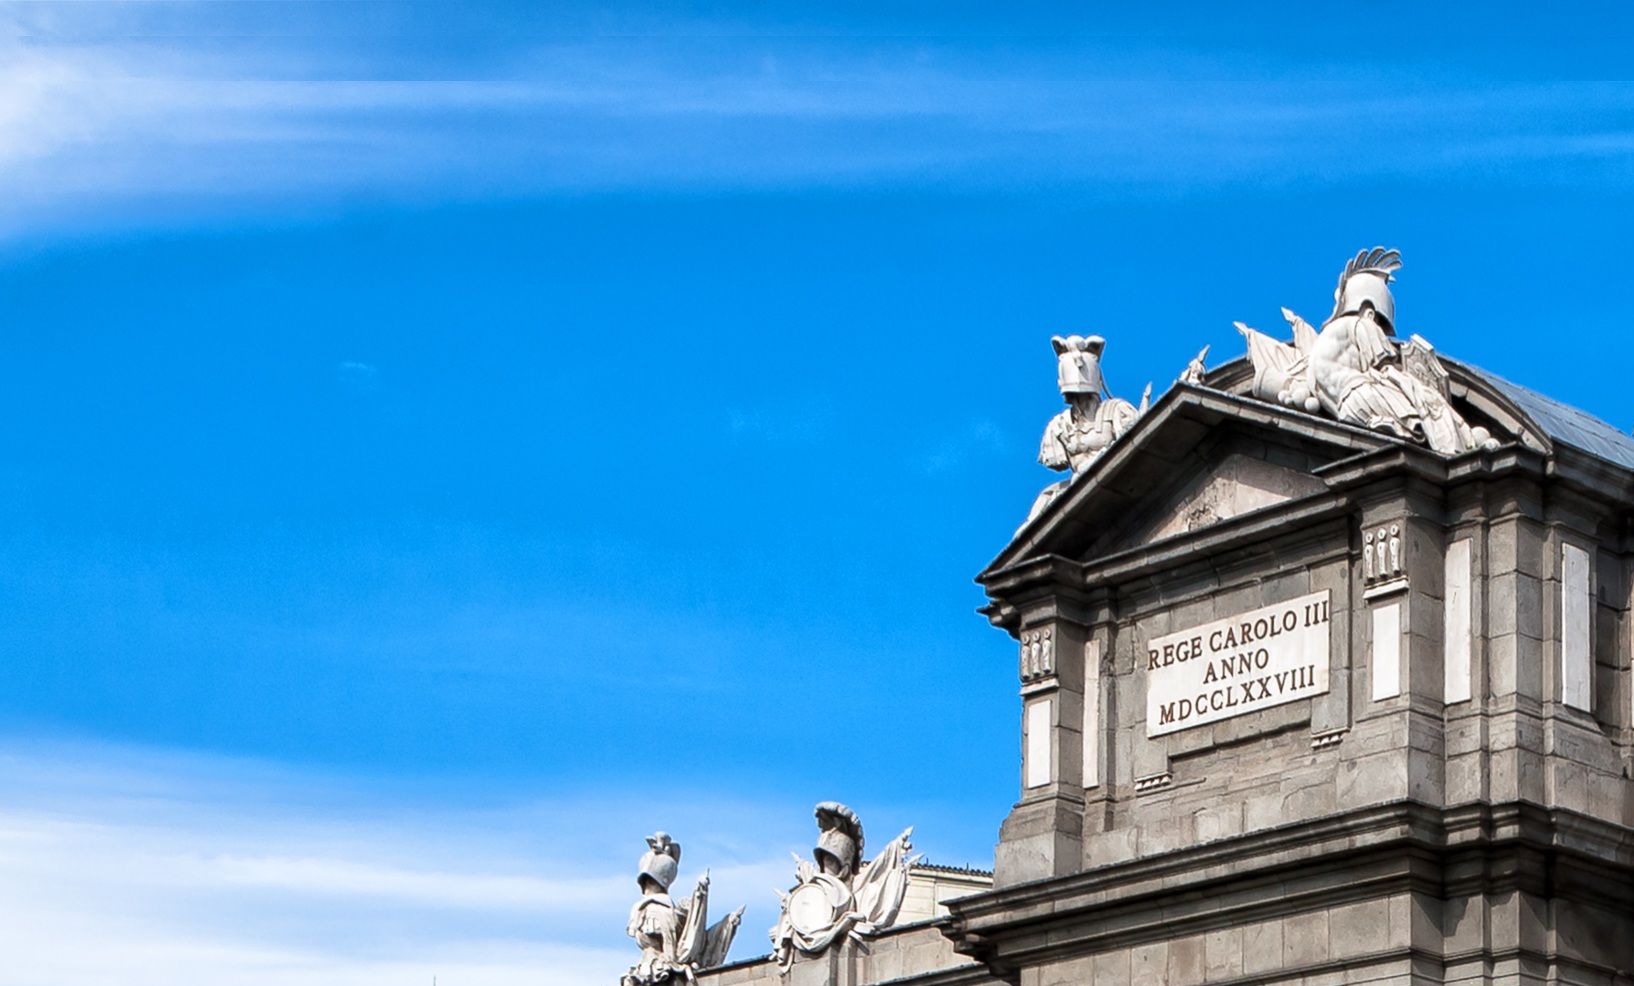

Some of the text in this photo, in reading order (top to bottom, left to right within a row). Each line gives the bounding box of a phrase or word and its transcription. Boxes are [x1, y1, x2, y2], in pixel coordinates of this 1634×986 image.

[1148, 601, 1329, 671] REGE CAROLO III
[1203, 648, 1269, 684] ANNO
[1159, 665, 1315, 725] MDCCLXXVIII
